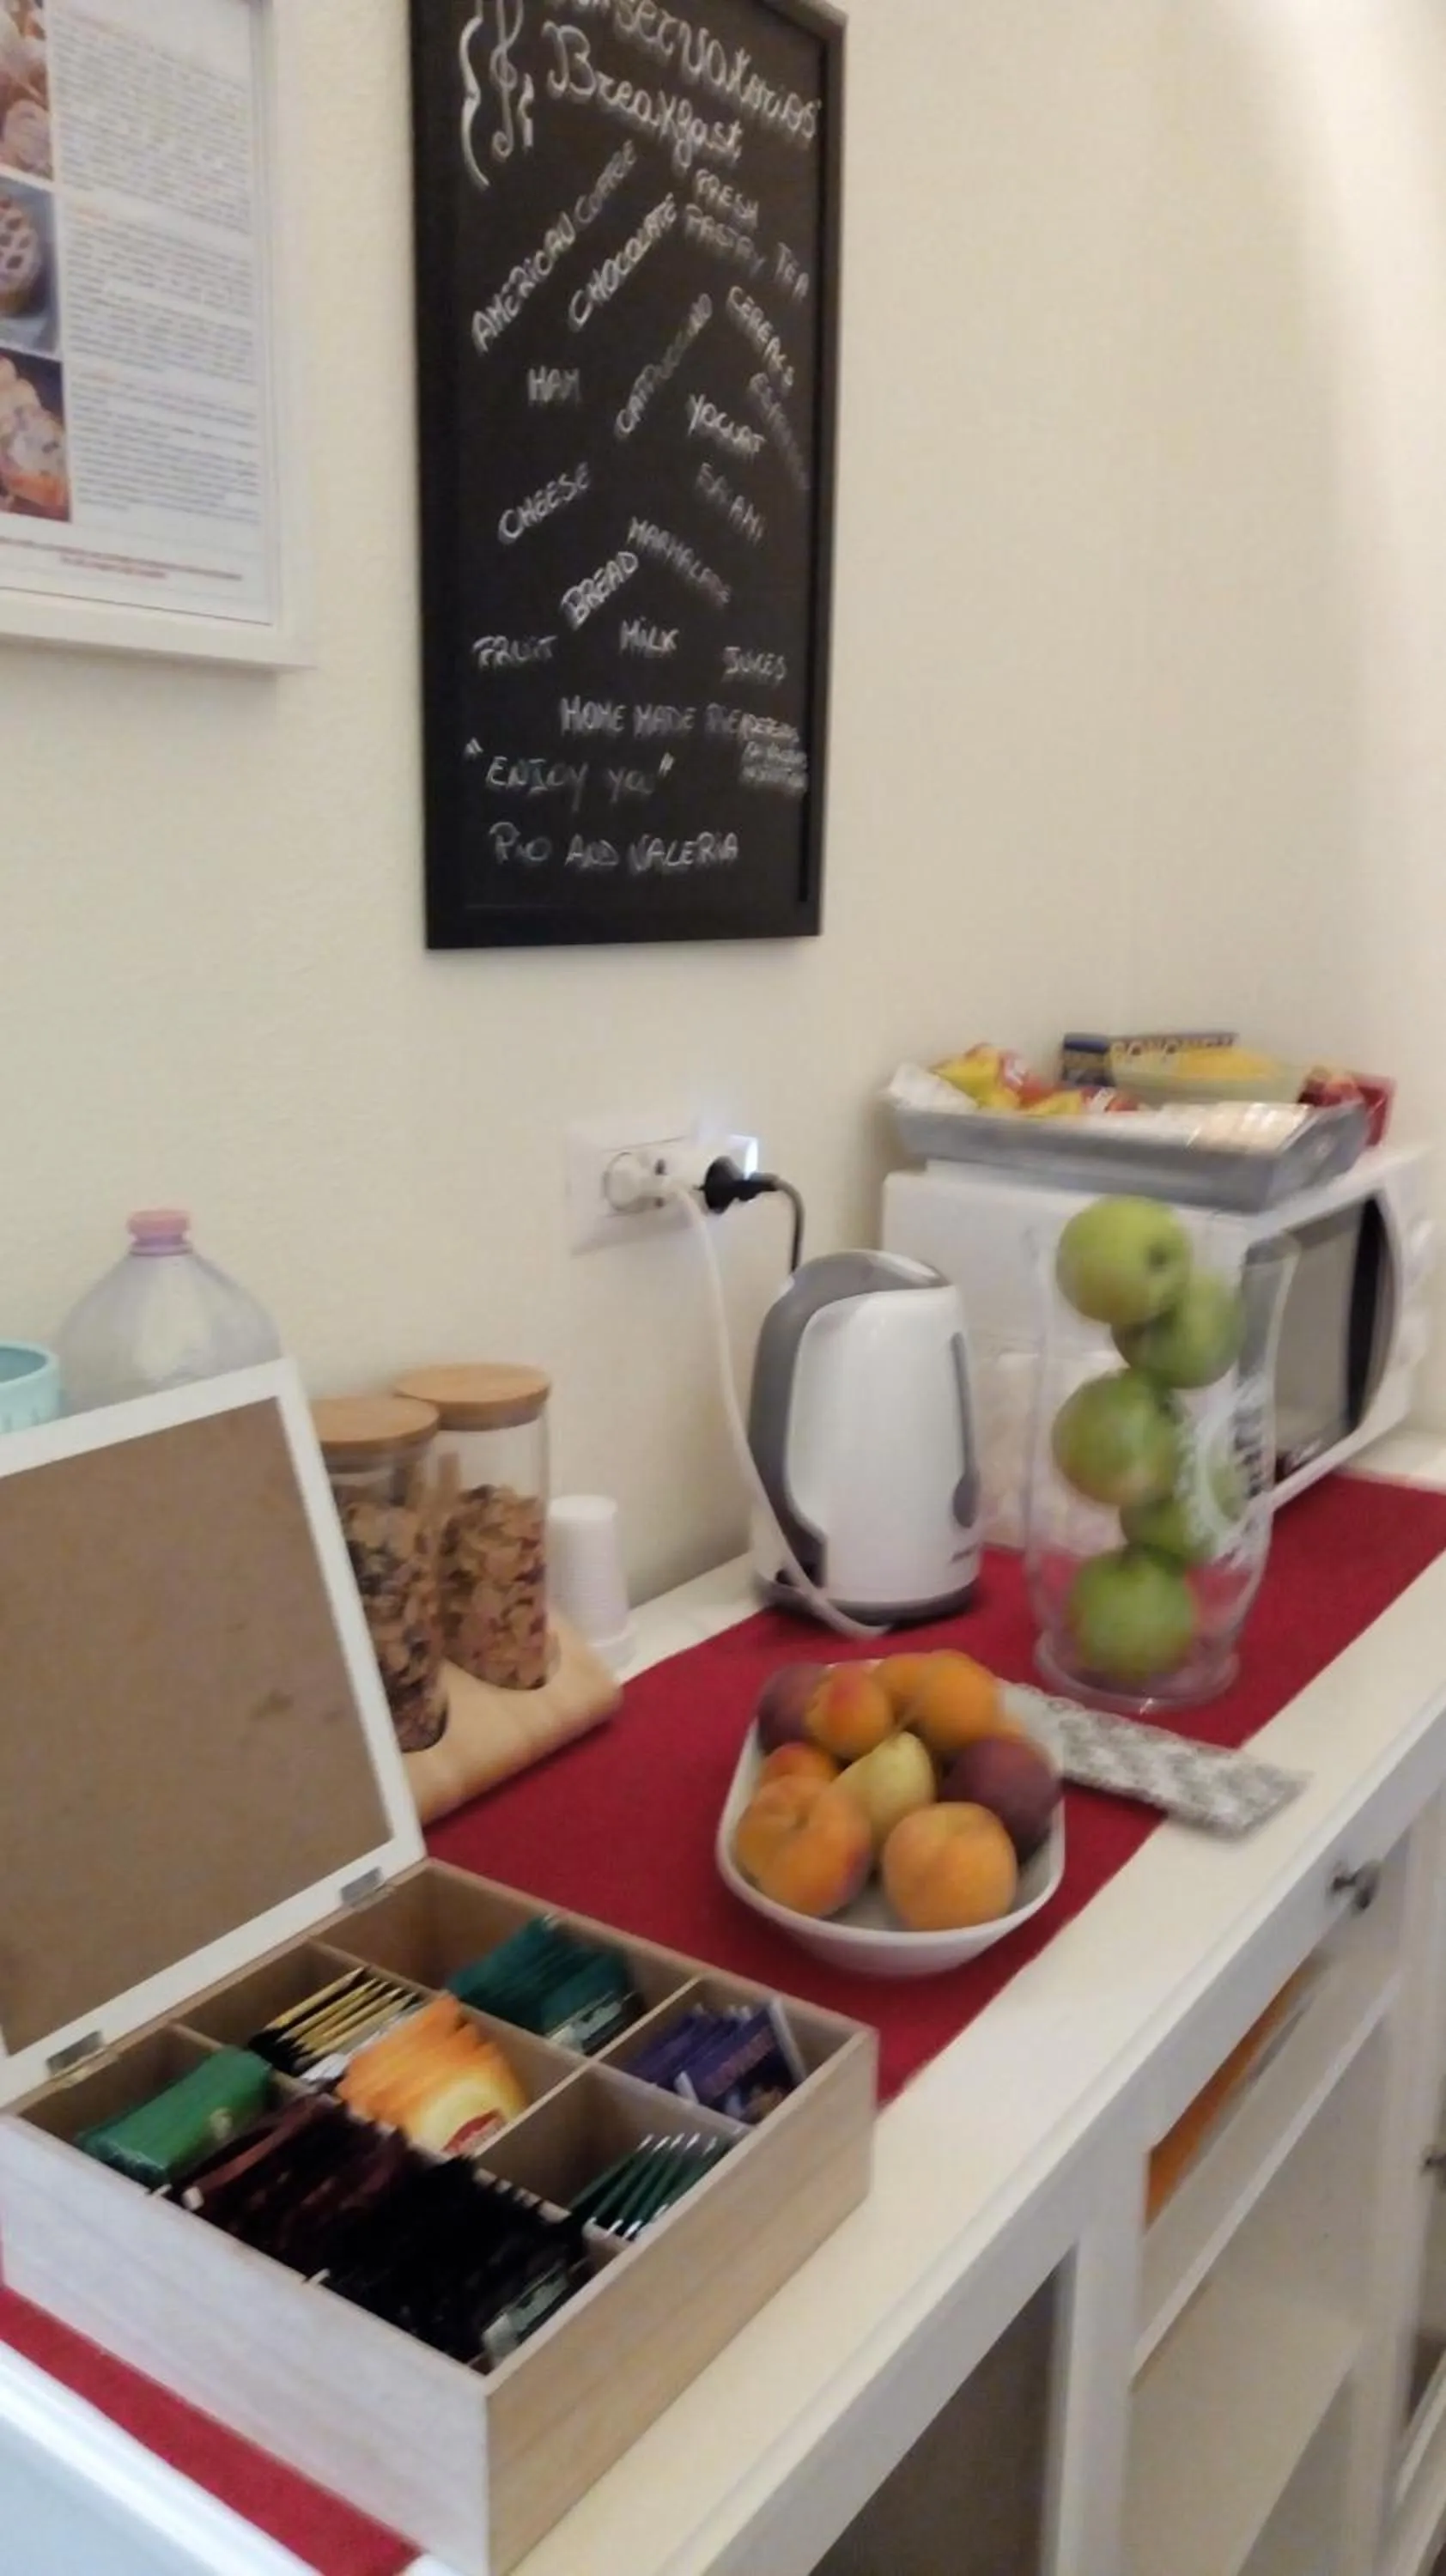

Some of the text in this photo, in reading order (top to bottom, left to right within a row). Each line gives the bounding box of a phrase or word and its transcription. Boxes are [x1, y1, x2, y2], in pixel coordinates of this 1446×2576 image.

[696, 169, 759, 228] FRESH
[471, 212, 576, 353] AMERICAN
[568, 192, 678, 329] CHOCOLATE
[526, 368, 581, 406] HAM
[499, 464, 591, 543] CHEESE
[561, 551, 638, 629] BREAD
[473, 636, 556, 666] FRUIT
[621, 616, 678, 655] MILK
[561, 696, 625, 734] HOME
[634, 704, 696, 737] MADE
[565, 834, 620, 867] AND
[628, 831, 738, 872] VALERIA
